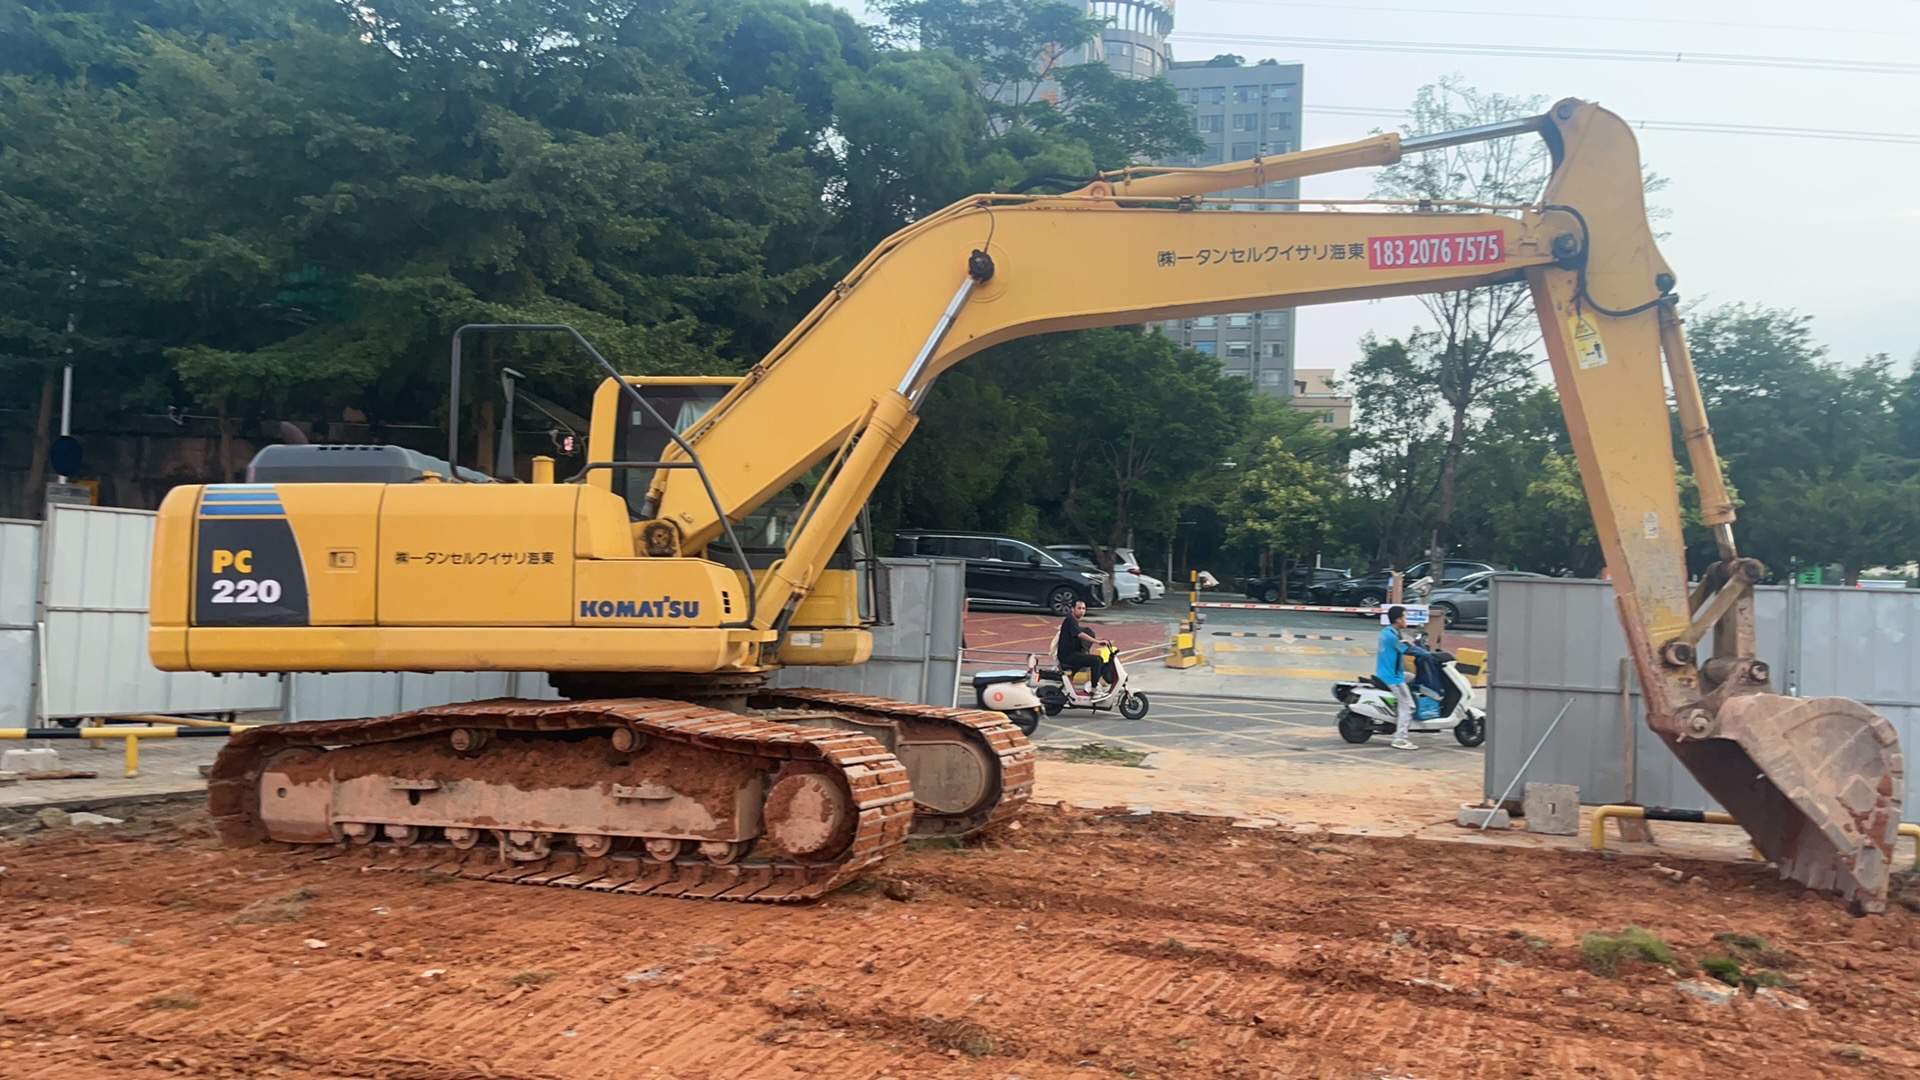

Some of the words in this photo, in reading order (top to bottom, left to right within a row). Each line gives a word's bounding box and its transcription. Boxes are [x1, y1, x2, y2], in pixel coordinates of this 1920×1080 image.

[1374, 240, 1405, 266] 183
[1409, 239, 1451, 264] 2076
[1455, 235, 1499, 262] 7575
[212, 550, 253, 573] PC
[211, 579, 282, 603] 220
[580, 596, 699, 618] KOMATSU
